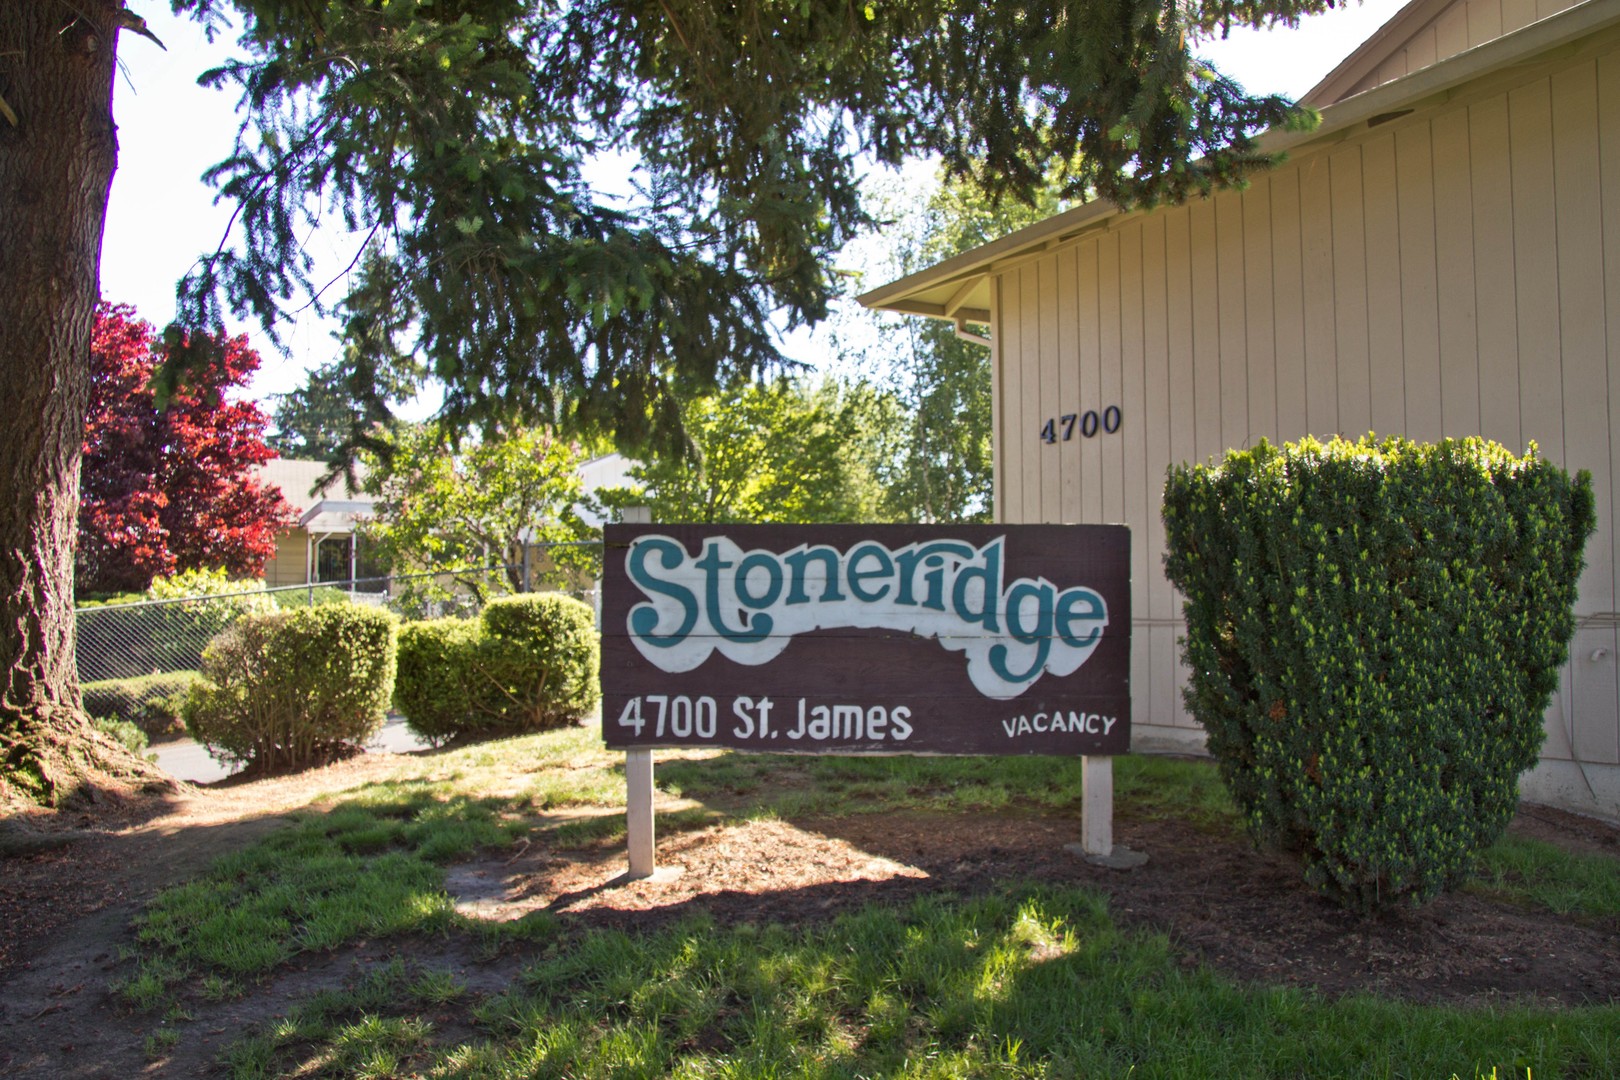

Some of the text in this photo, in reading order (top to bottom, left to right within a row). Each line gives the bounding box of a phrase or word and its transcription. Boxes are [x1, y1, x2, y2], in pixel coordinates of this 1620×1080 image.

[1040, 405, 1121, 444] 4700
[628, 538, 1106, 684] Stoneridge
[618, 695, 914, 741] 4700 St. James
[1002, 711, 1117, 738] VACANCY
